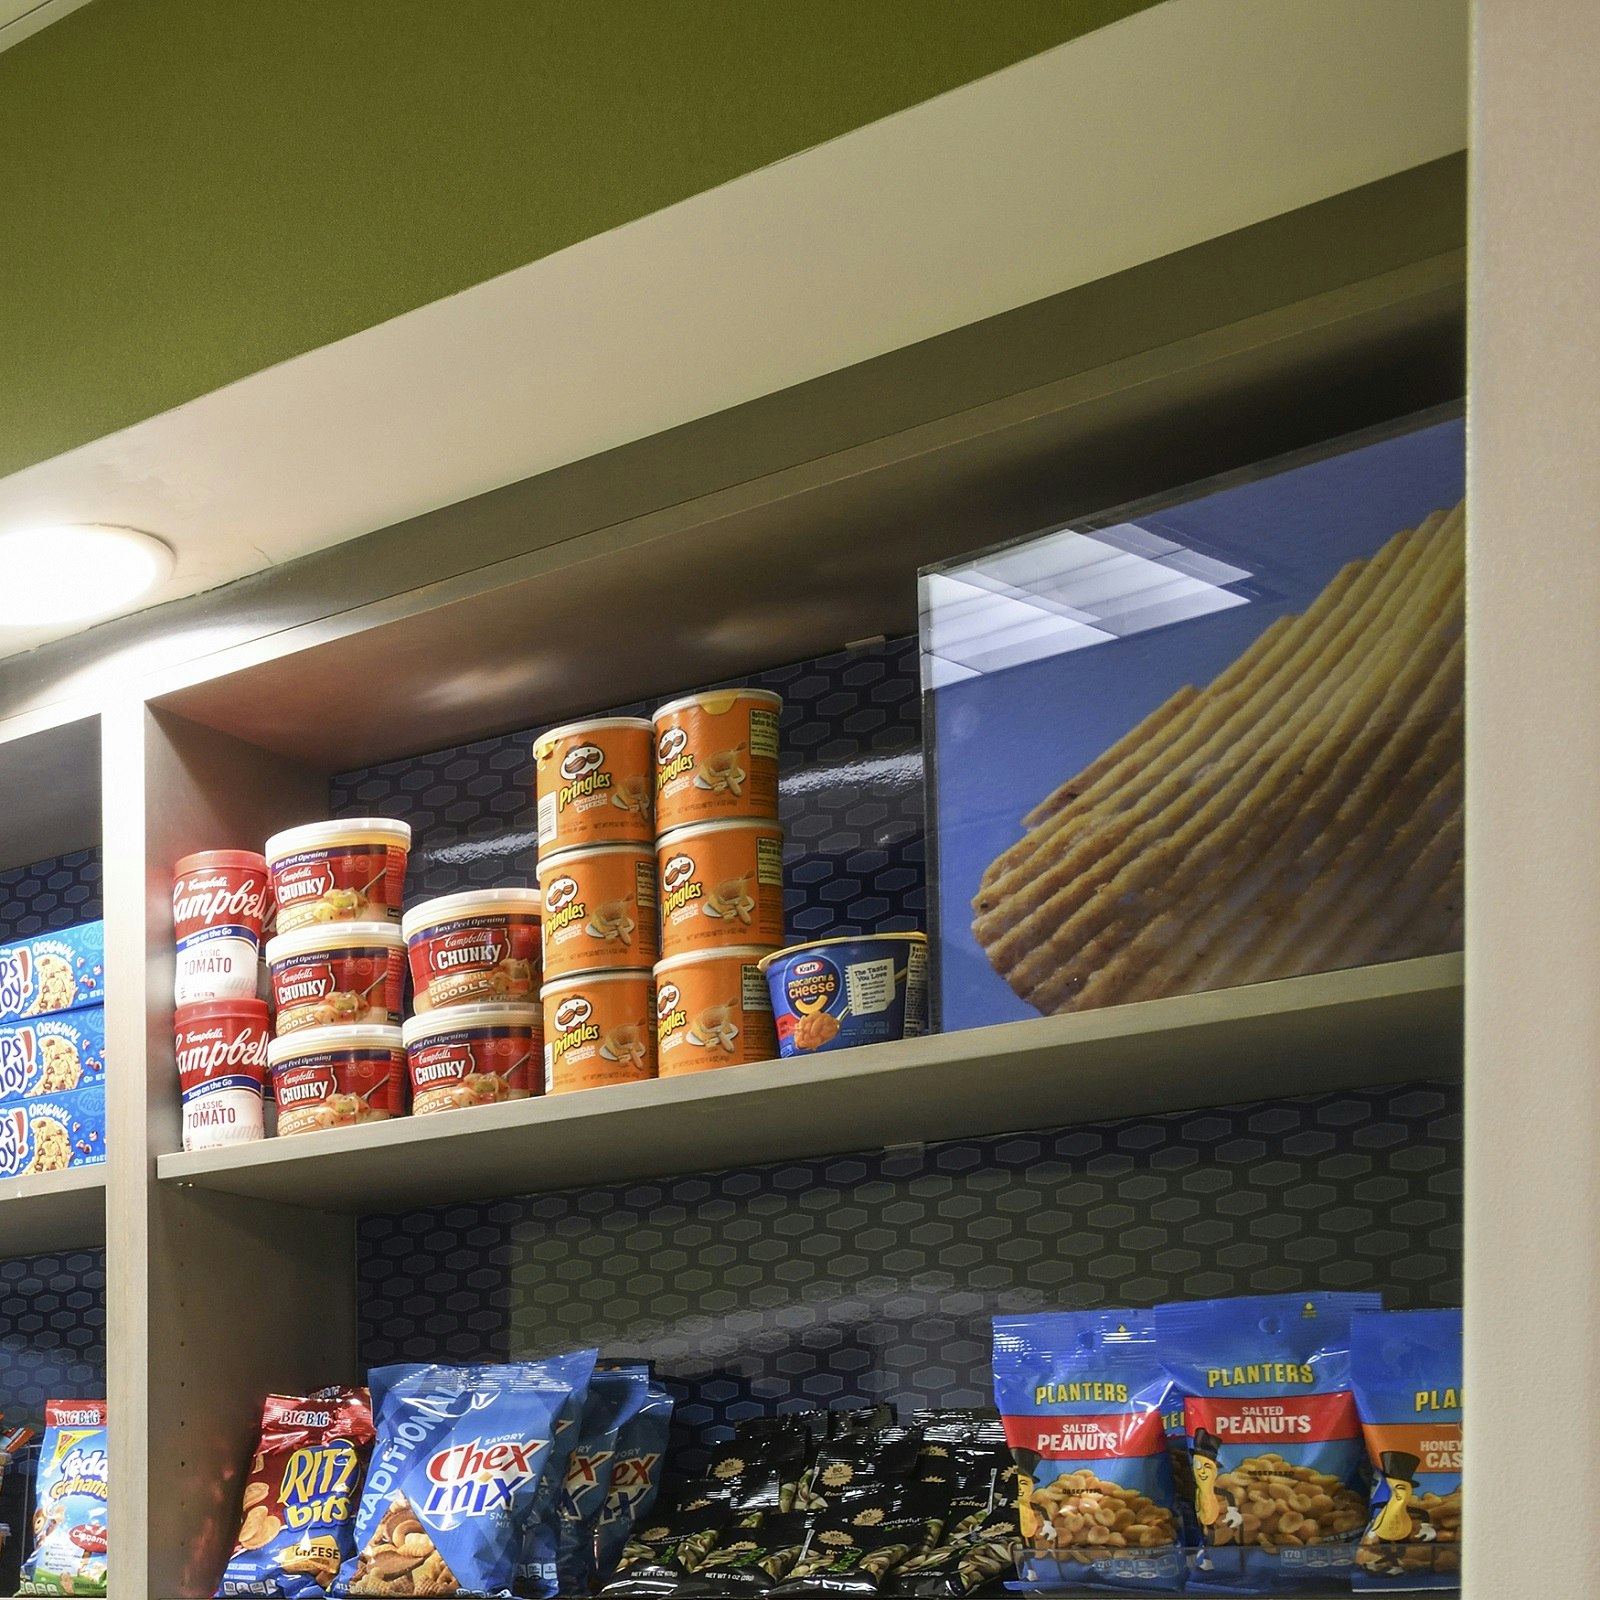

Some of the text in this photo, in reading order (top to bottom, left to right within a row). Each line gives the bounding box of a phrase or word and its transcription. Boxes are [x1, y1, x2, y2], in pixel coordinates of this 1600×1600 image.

[559, 772, 611, 813] Pringles
[576, 799, 608, 814] CHEESE
[277, 877, 325, 903] CHUNKY
[222, 927, 233, 936] Go
[471, 917, 506, 926] Opening
[32, 942, 76, 961] ORIGINAL
[436, 944, 502, 970] CHUNKY
[184, 956, 232, 976] TOMATO
[799, 964, 816, 973] Kraft
[867, 964, 888, 974] Taste
[788, 974, 827, 988] macaroni
[858, 971, 887, 983] You Love
[278, 979, 328, 1004] CHUNKY
[431, 979, 488, 1005] NOODLE
[37, 1022, 81, 1043] ORIGINAL
[554, 1023, 599, 1064] Pringles
[222, 1077, 233, 1087] Go
[415, 1059, 466, 1085] CHUNKY
[280, 1079, 329, 1105] CHUNKY
[28, 1104, 73, 1127] ORIGINAL
[195, 1100, 223, 1111] CLASSIC
[188, 1107, 237, 1129] TOMATO
[1207, 1363, 1315, 1389] PLANTERS
[1034, 1381, 1129, 1406] PLANTERS
[56, 1409, 101, 1425] BIG BAG
[280, 1410, 330, 1426] BIG BAG
[1241, 1404, 1285, 1417] SALTED
[1061, 1422, 1100, 1435] SALTED
[1215, 1414, 1312, 1435] PEANUTS
[483, 1432, 526, 1446] SAVORY
[1037, 1431, 1118, 1452] PEANUTS
[428, 1440, 548, 1483] Chex
[277, 1447, 358, 1505] RITZ
[424, 1470, 531, 1515] mix
[286, 1495, 351, 1529] bits
[294, 1545, 340, 1560] CHEESE
